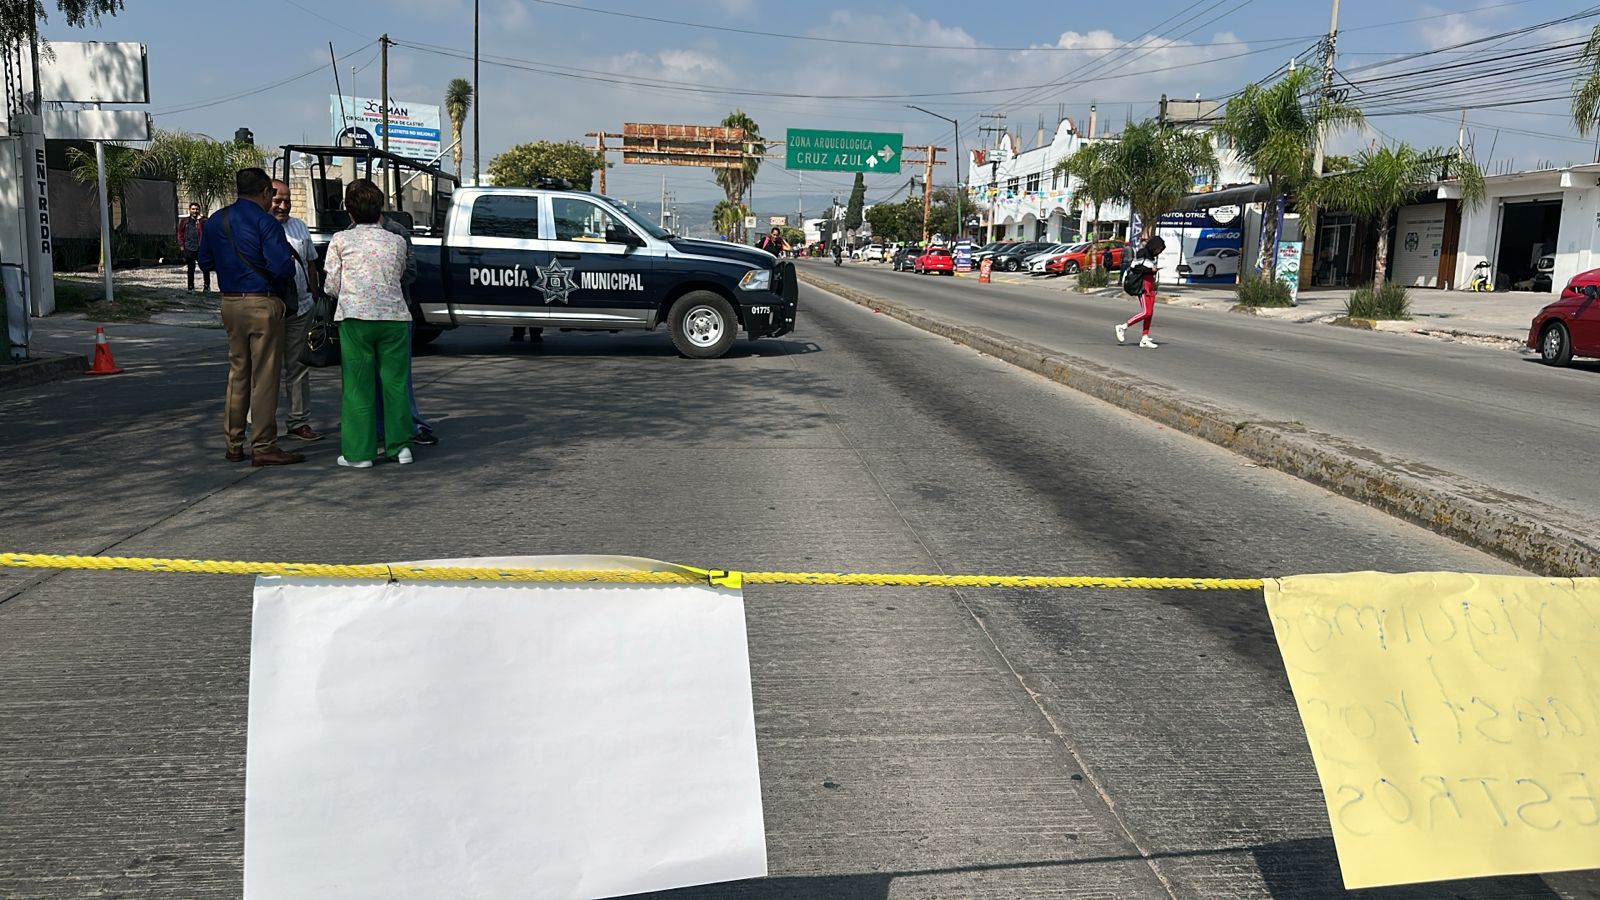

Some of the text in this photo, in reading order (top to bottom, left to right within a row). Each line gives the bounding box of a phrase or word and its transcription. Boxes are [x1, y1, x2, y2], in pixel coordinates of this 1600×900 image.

[790, 136, 873, 150] ZONA ARQUEOLOGICA
[797, 152, 863, 166] CRUZ AZUL
[35, 148, 51, 254] ENTRADA
[469, 265, 644, 291] POLICÍA MUNICIPAL
[751, 306, 771, 315] 01775
